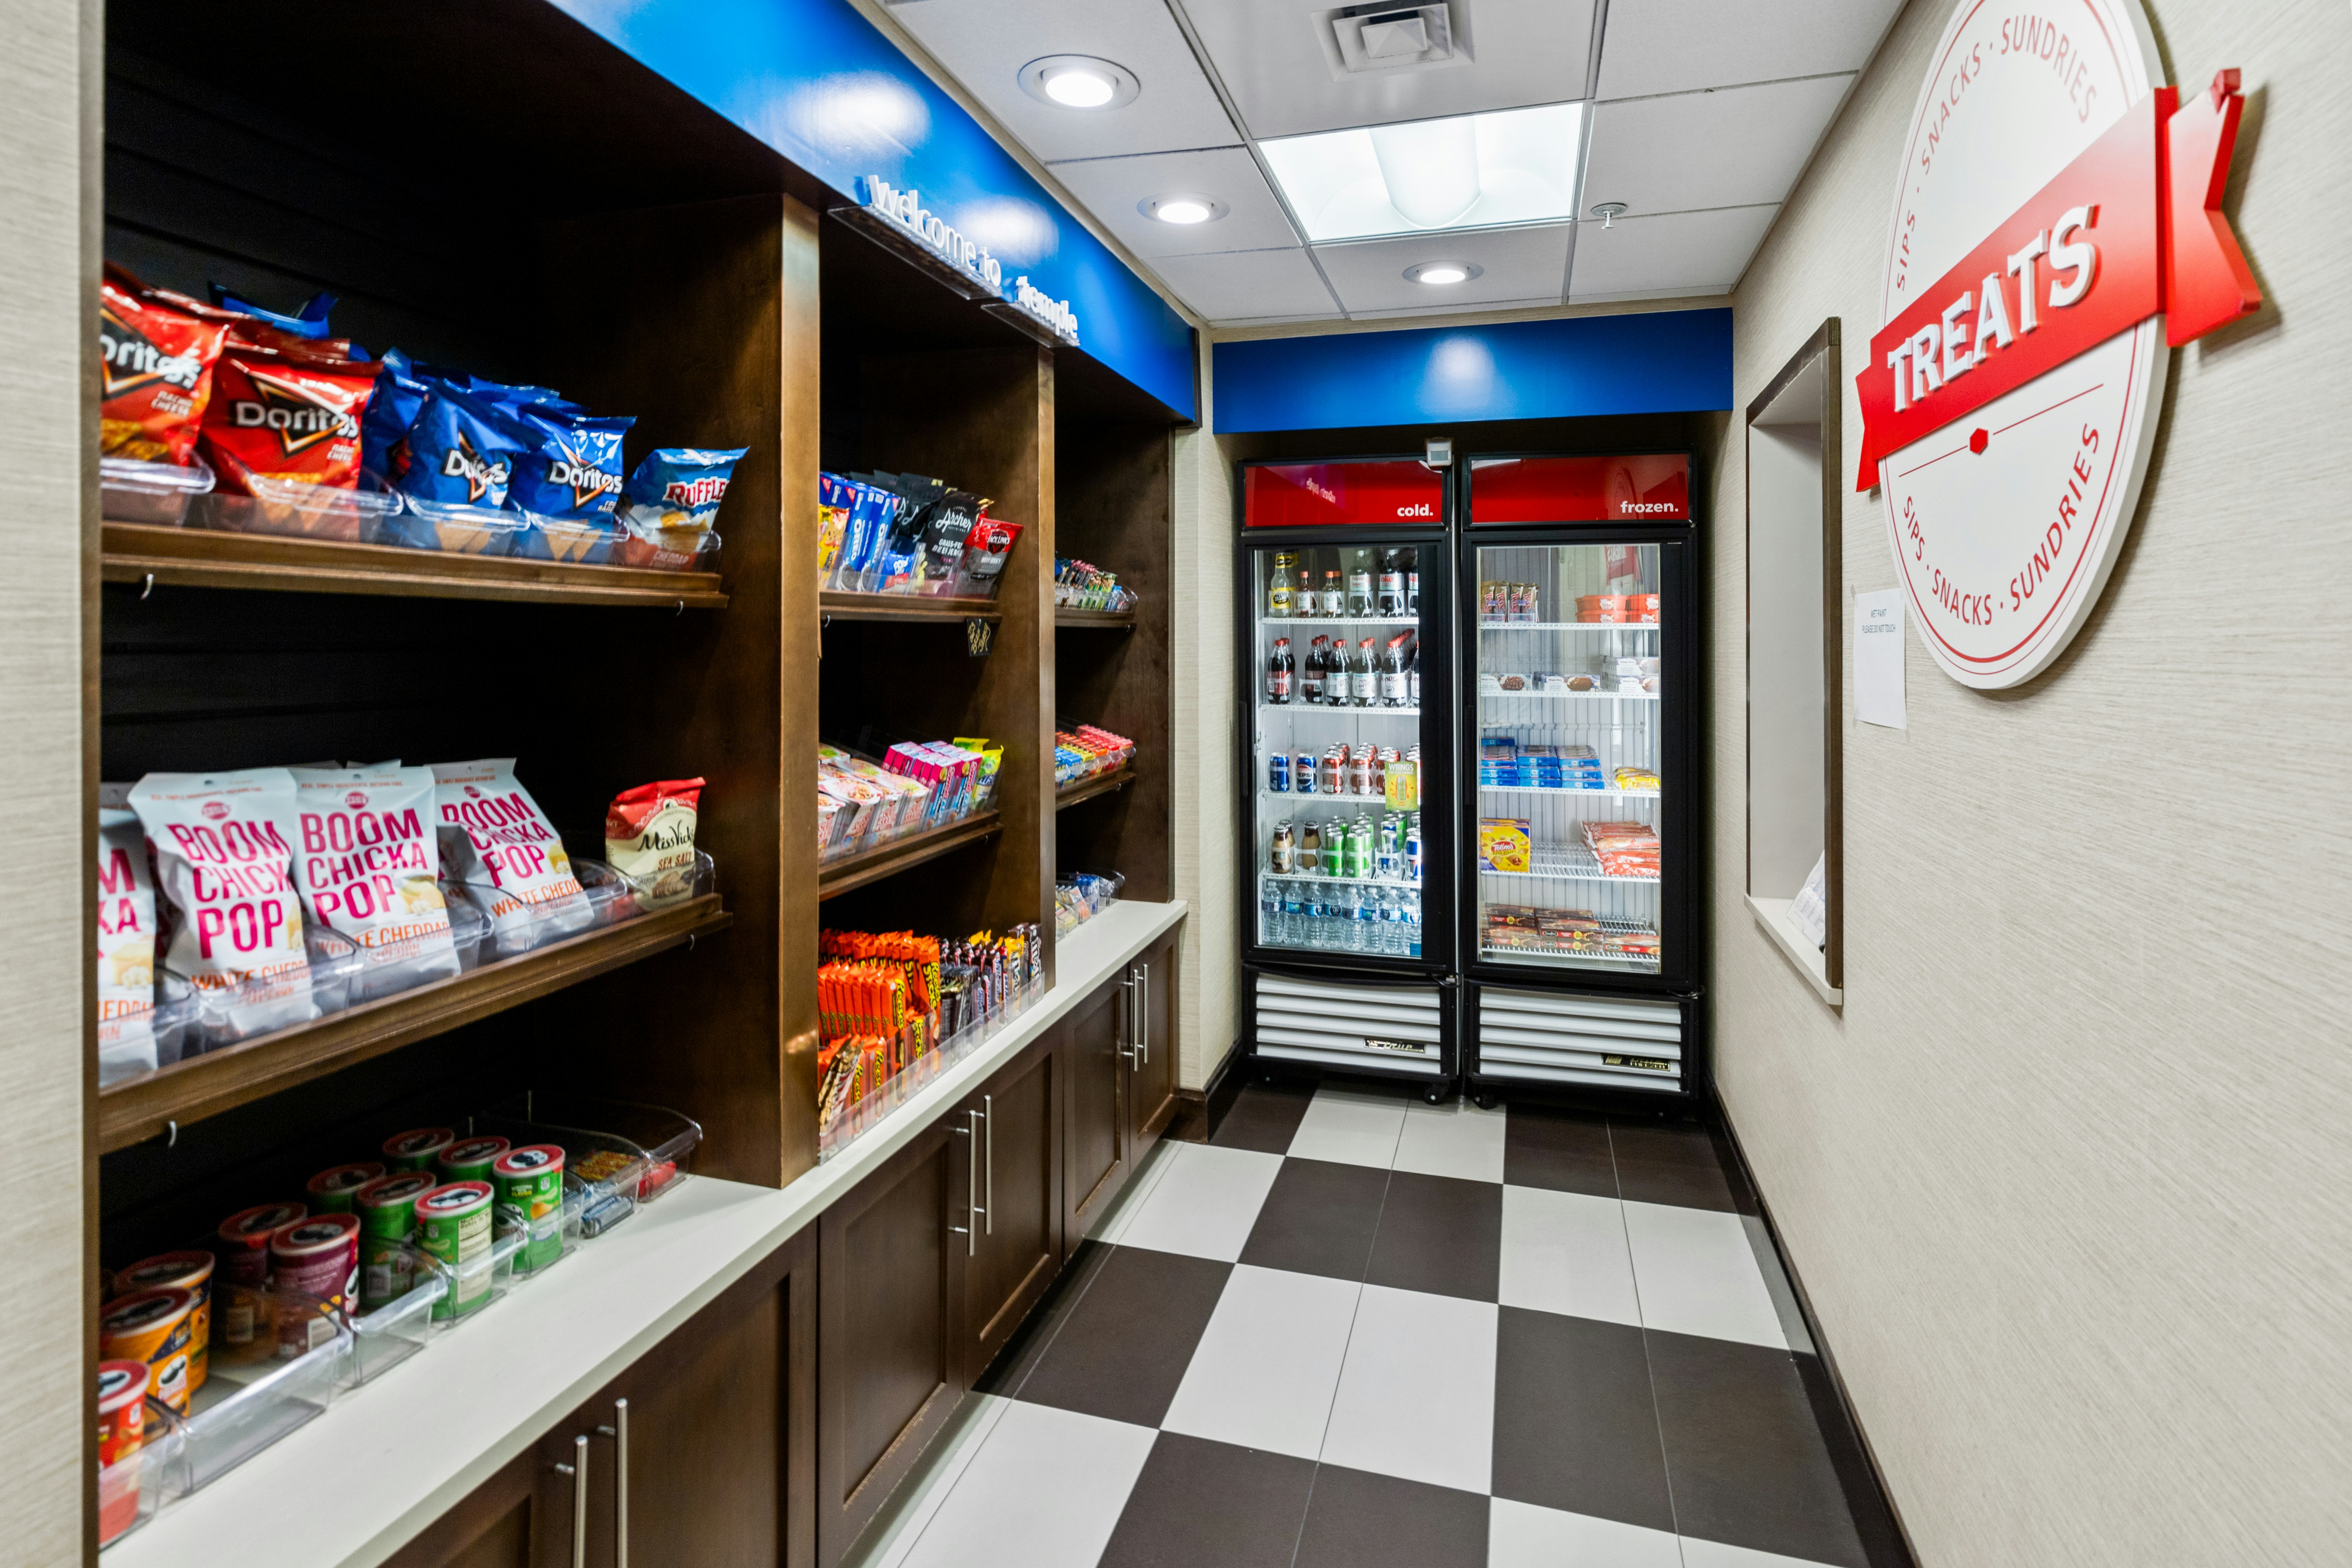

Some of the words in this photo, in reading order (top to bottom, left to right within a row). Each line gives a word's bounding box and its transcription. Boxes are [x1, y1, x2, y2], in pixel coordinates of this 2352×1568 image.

[1897, 209, 1916, 291] SIPS
[1922, 42, 1981, 175] SNACKS
[2001, 15, 2096, 123] SUNDRIES
[868, 175, 976, 271] Welcome
[979, 247, 1001, 287] to
[1888, 205, 2098, 412] TREATS
[100, 334, 202, 389] oritos
[236, 401, 358, 438] Doritos
[549, 461, 623, 494] Doritos
[936, 508, 972, 533] Archer
[1397, 504, 1433, 517] cold.
[1620, 501, 1678, 513] frozen.
[1904, 496, 1925, 561] SIPS
[1932, 569, 1992, 625] SNACKS
[2010, 423, 2099, 611] SUNDRIES
[851, 518, 862, 561] OREO
[1862, 625, 1873, 633] PLEASE
[1885, 624, 1896, 633] TOUCH
[1877, 609, 1886, 617] PAINT
[299, 808, 424, 854] BOOM
[441, 792, 536, 829] BOOM
[167, 820, 292, 864] BOOM
[638, 831, 675, 852] Miss
[658, 858, 673, 871] SEA
[675, 851, 692, 865] SALT
[1493, 843, 1513, 851] Totino's
[193, 860, 294, 903] CHICK
[307, 841, 428, 889] CHICKA
[481, 844, 545, 888] POP
[311, 874, 396, 928] POP
[491, 889, 541, 918] WHITE
[541, 877, 583, 901] CHEDD
[196, 899, 283, 959] POP
